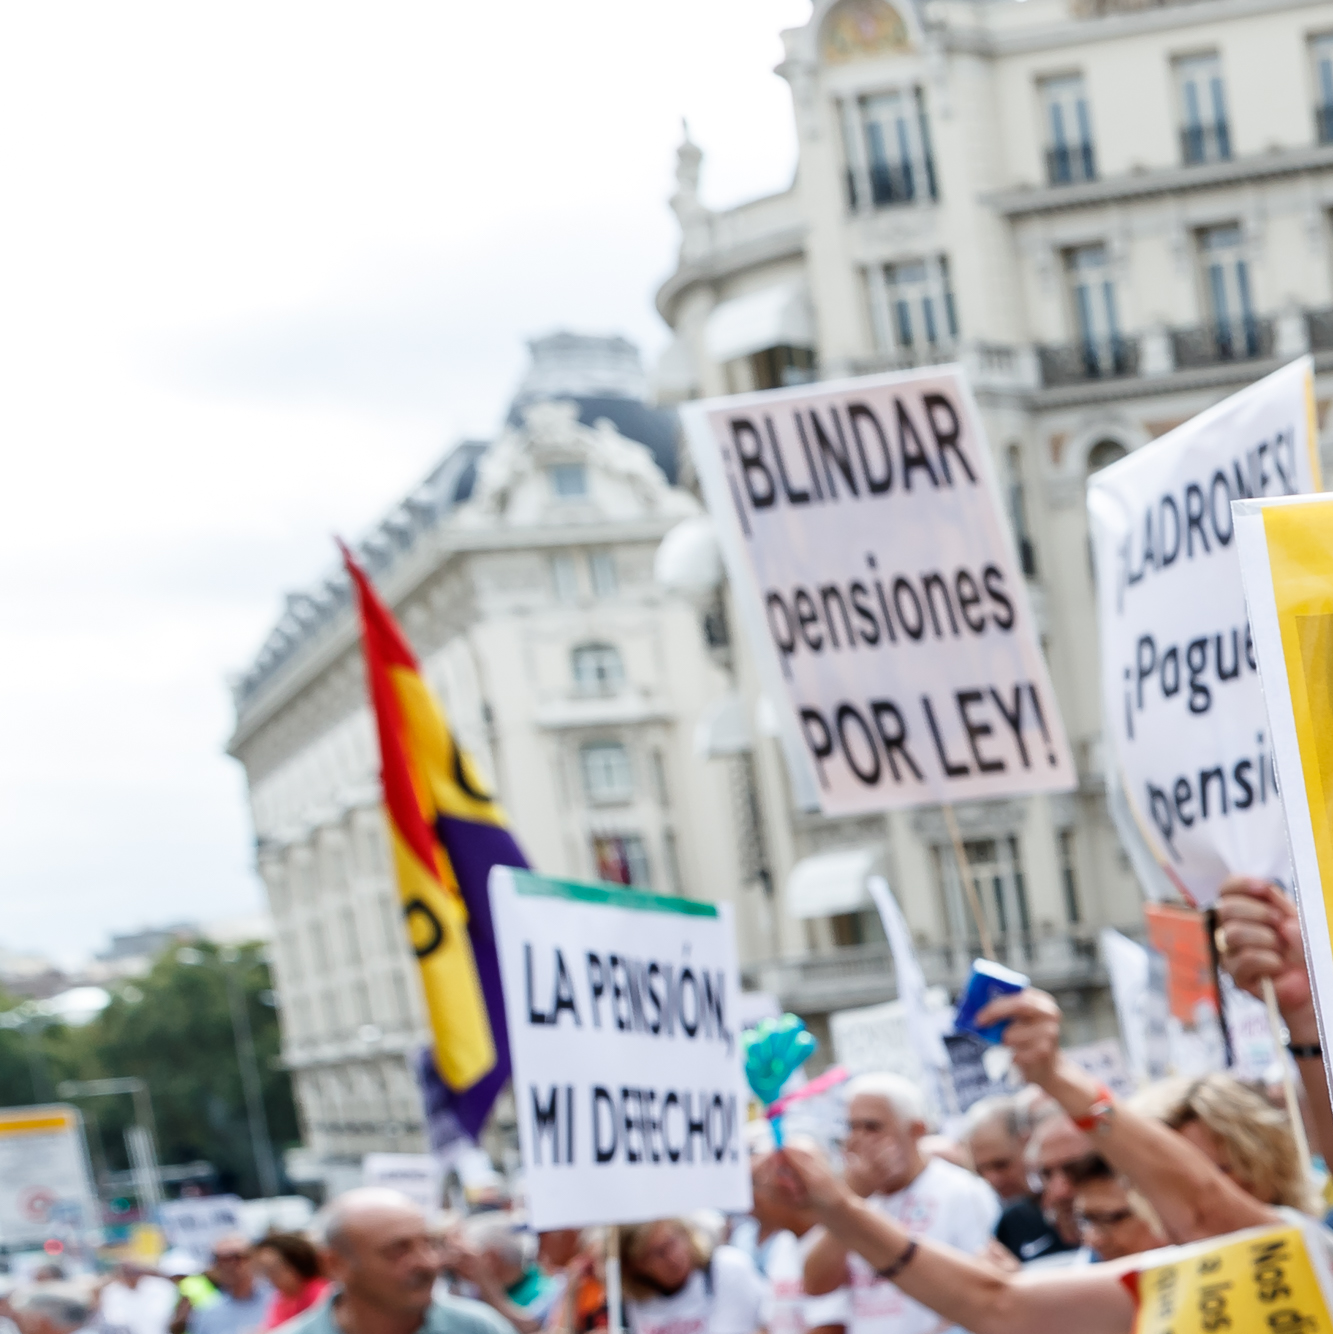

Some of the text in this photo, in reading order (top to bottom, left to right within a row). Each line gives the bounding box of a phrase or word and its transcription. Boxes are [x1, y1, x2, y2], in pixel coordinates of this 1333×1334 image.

[765, 550, 1016, 680] pensiones
[799, 681, 1060, 792] POR LEY!
[1146, 734, 1281, 863] pensi
[524, 940, 582, 1028] LA
[530, 1082, 574, 1166] MI
[1197, 1281, 1233, 1334] los
[1250, 1238, 1293, 1304] Nos
